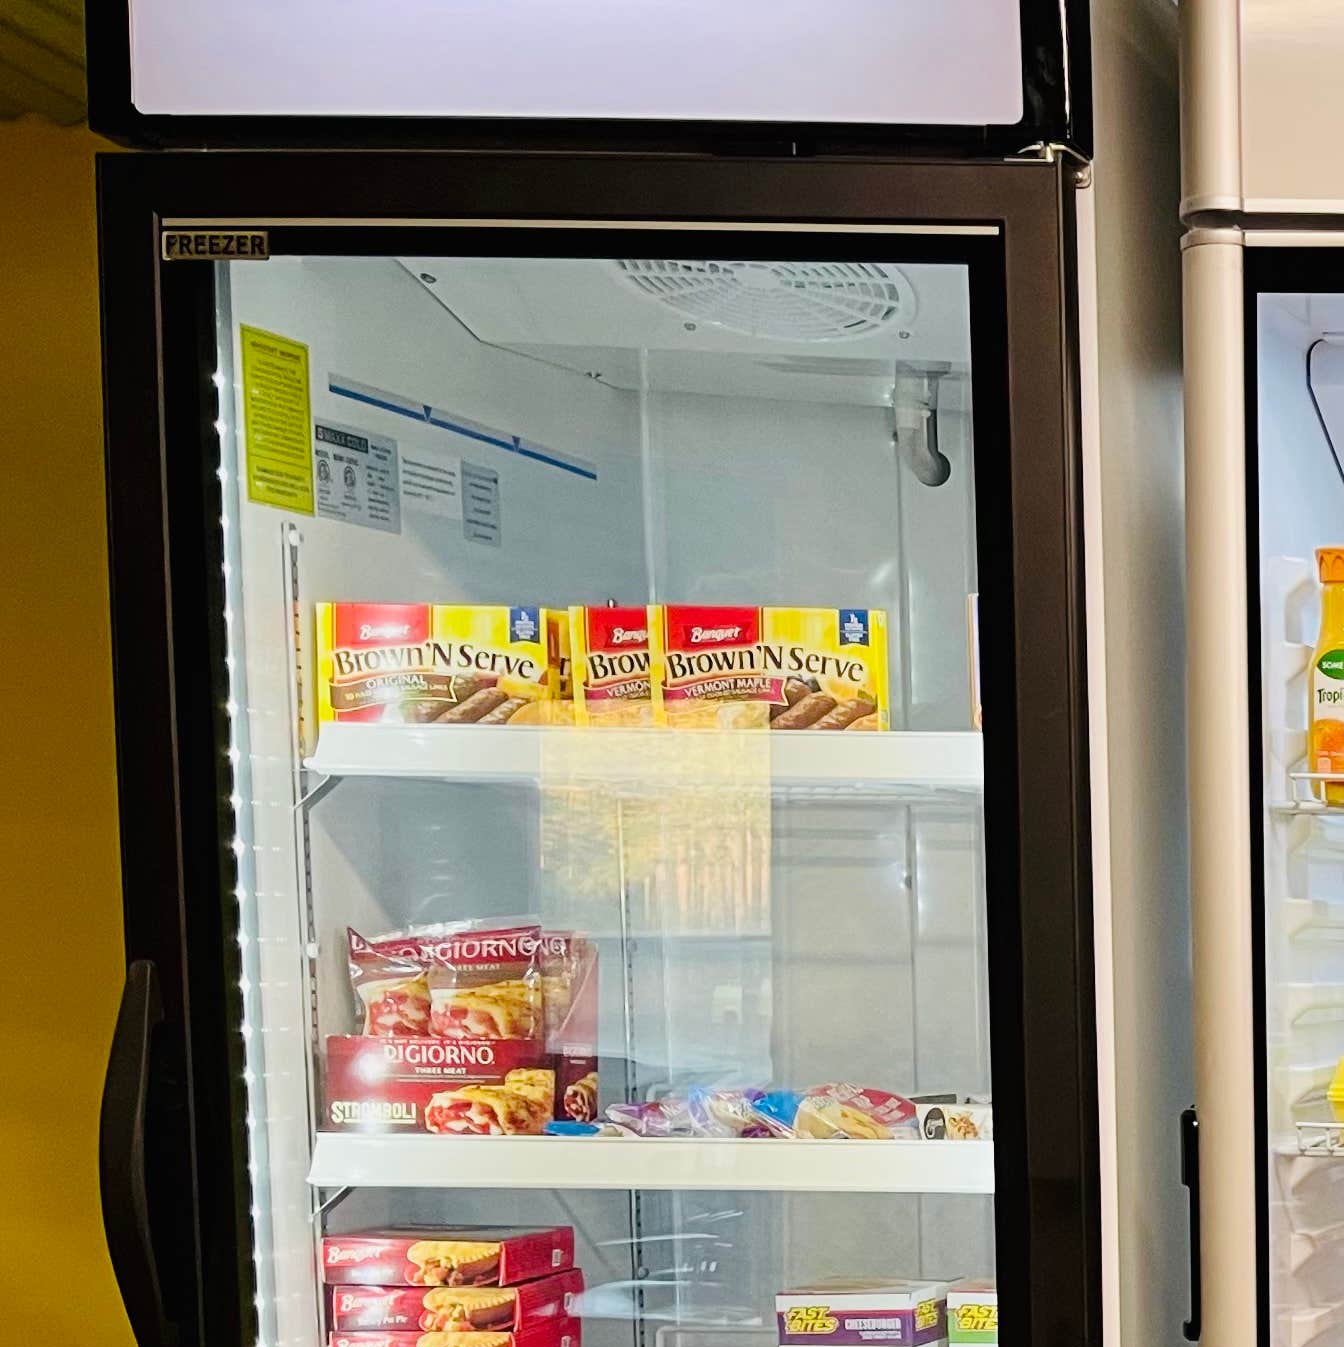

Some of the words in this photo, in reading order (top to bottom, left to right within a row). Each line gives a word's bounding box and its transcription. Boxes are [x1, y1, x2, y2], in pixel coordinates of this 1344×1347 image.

[165, 234, 266, 255] FREEZER
[690, 626, 742, 644] Banquet
[457, 644, 535, 680] Serve
[588, 653, 650, 681] Brow
[788, 646, 864, 683] Serve
[1321, 660, 1344, 671] SOME
[365, 674, 426, 690] ORIGINAL
[684, 680, 735, 698] VERMONT
[737, 678, 772, 692] MAPLE
[383, 1045, 493, 1065] DIGIORNO
[331, 1100, 417, 1125] STROMBOLI
[789, 1306, 831, 1321] FAST
[787, 1319, 838, 1333] BITES
[958, 1318, 997, 1331] BITE
